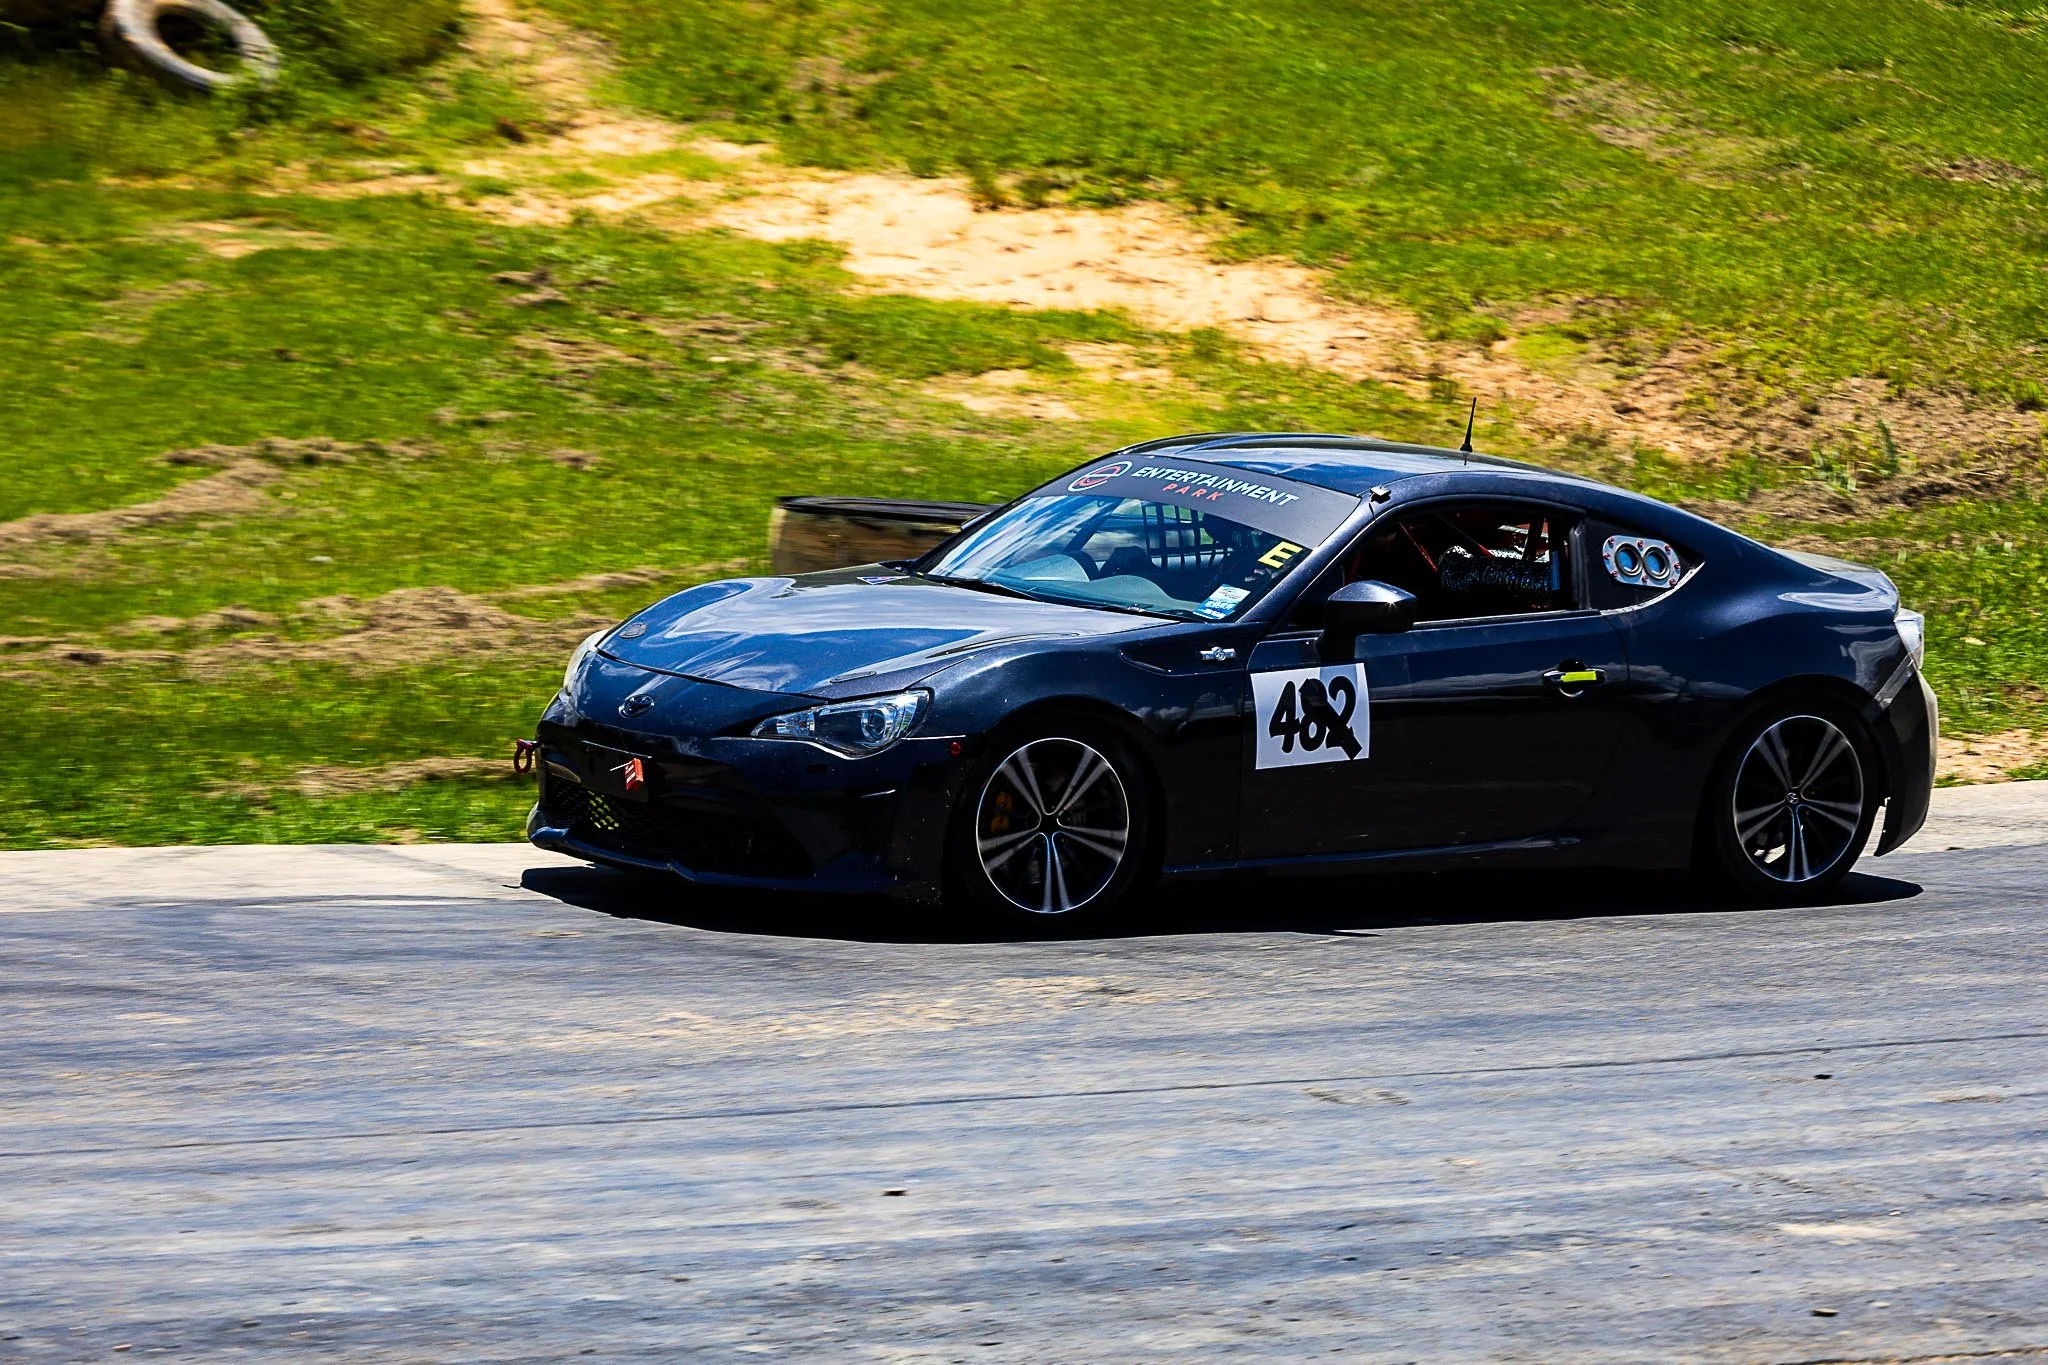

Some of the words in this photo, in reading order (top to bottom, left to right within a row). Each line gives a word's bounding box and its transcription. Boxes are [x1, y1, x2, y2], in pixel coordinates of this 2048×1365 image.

[1131, 466, 1299, 506] ENTERTAINMENT
[1162, 483, 1224, 501] PARK
[1258, 541, 1303, 568] E
